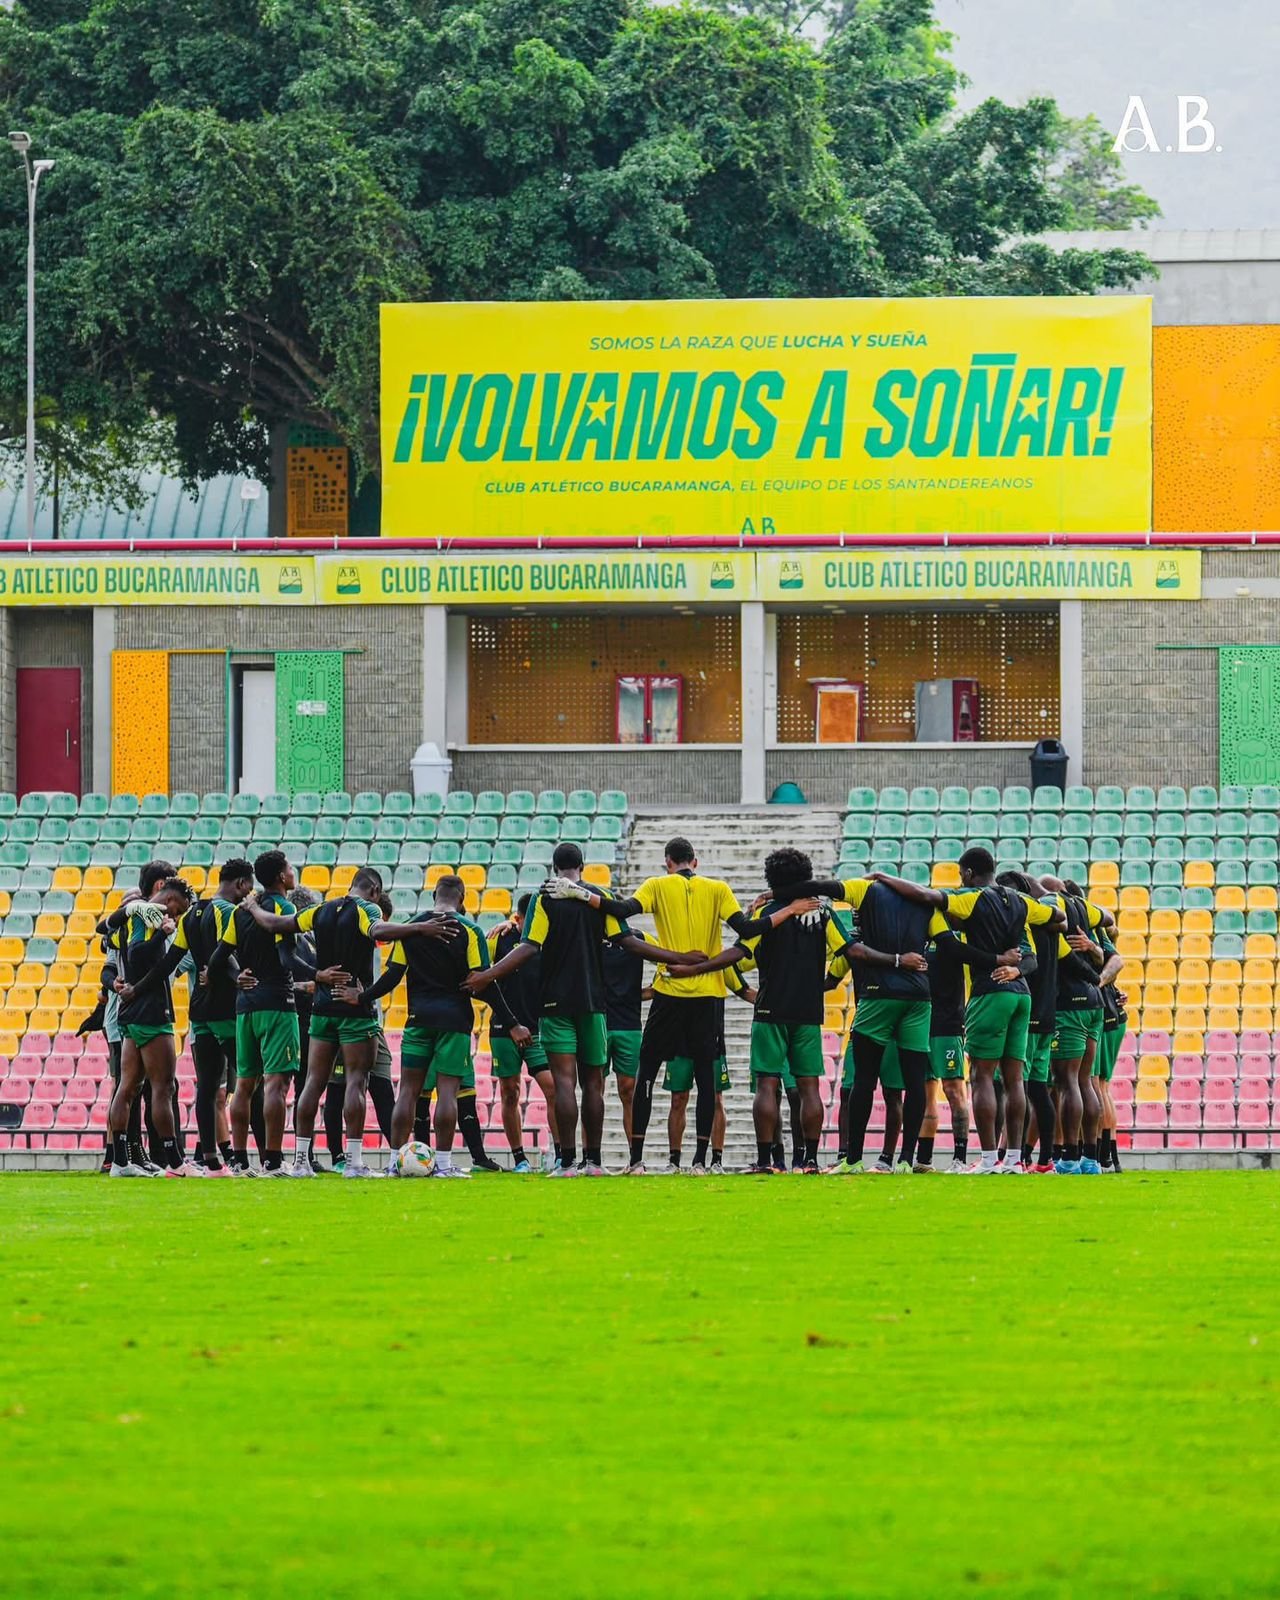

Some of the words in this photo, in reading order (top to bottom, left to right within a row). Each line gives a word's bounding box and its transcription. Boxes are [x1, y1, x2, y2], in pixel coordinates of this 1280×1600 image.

[590, 336, 654, 350] SOMOS
[660, 336, 681, 350] LA
[687, 336, 734, 349] RAZA
[740, 335, 777, 351] QUE
[782, 335, 844, 349] LUCHA
[851, 335, 862, 348] Y
[866, 330, 928, 348] SUEÑA
[393, 370, 785, 463] ¡VOLVAMOS
[795, 370, 848, 460] A
[863, 353, 1126, 459] SOÑAR!
[484, 481, 526, 494] CLUB
[530, 478, 604, 494] ATLÉTICO
[608, 480, 736, 494] BUCARAMANGA,
[740, 480, 758, 492] EL
[762, 479, 823, 492] EQUIPO
[827, 479, 848, 491] DE
[853, 479, 882, 491] LOS
[887, 478, 1034, 490] SANTANDEREANOS
[12, 567, 98, 593] ATLETICO
[105, 567, 260, 593] BUCARAMANGA
[381, 566, 431, 593] CLUB
[437, 565, 523, 592] ATLETICO
[530, 563, 687, 591] BUCARAMANGA
[824, 561, 875, 588] CLUB
[880, 561, 968, 588] ATLETICO
[974, 561, 1133, 588] BUCARAMANGA
[945, 1049, 956, 1060] 27
